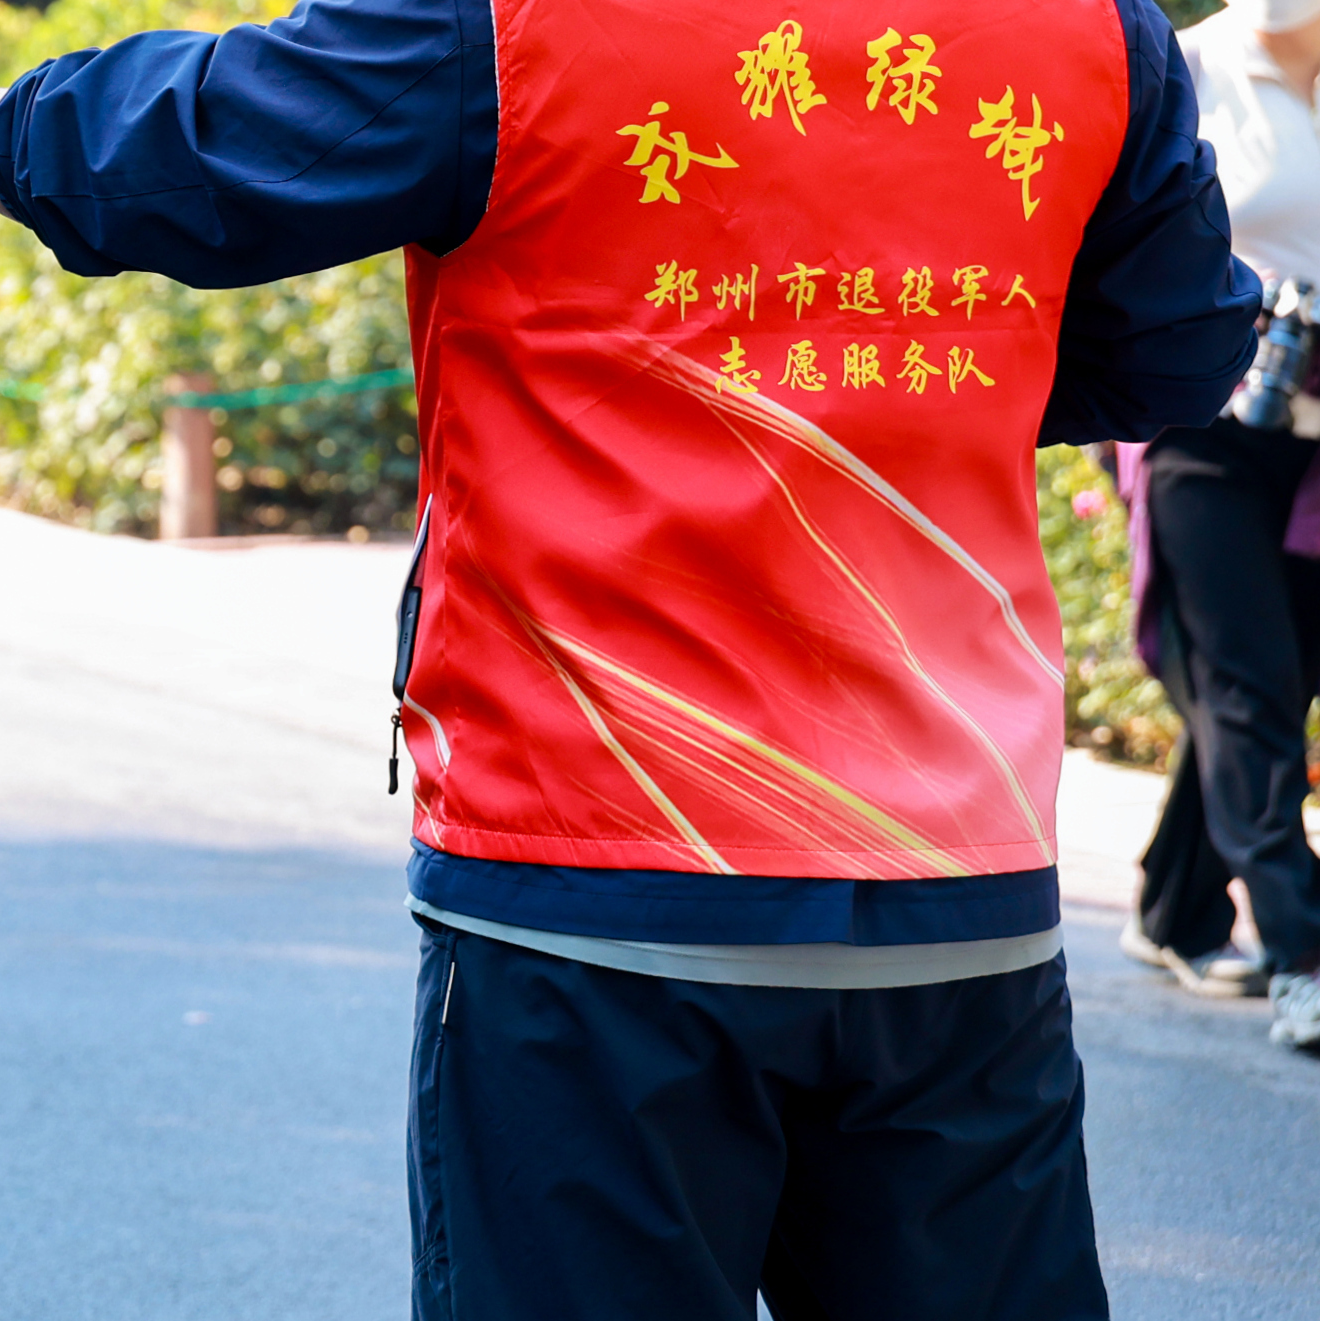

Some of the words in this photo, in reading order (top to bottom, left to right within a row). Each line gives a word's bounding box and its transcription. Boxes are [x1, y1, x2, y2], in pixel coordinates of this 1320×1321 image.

[644, 260, 1037, 322] 郑州市退役军人
[713, 336, 996, 395] 志愿服务队
